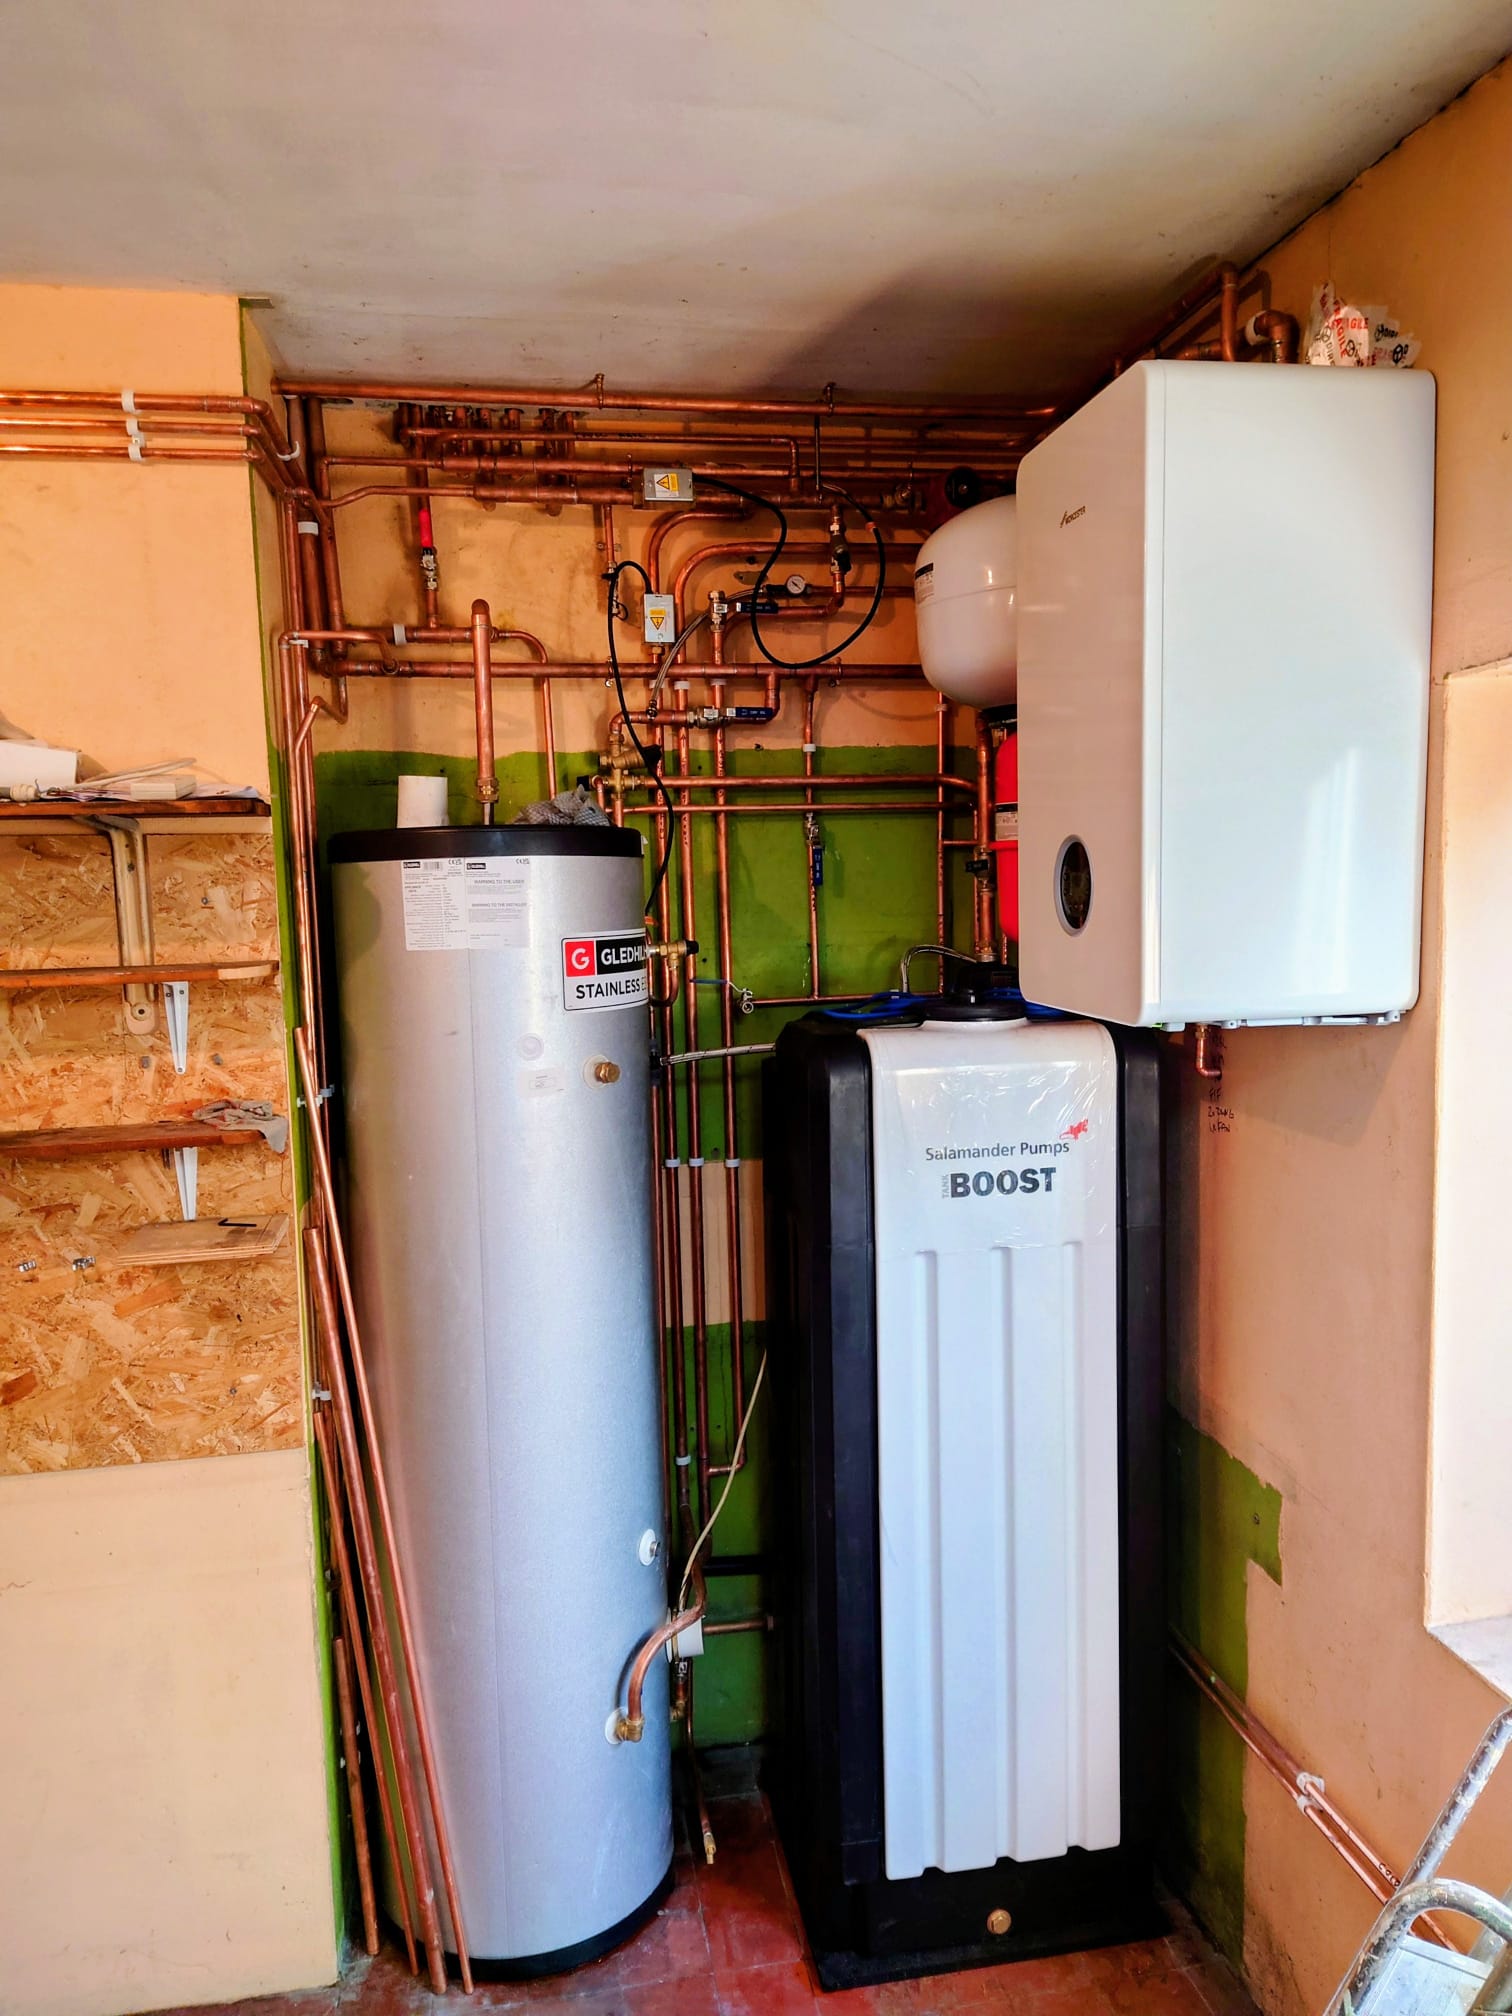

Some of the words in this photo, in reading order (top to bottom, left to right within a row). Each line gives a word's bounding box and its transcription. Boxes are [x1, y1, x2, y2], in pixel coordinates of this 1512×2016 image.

[571, 948, 590, 970] G
[576, 978, 641, 999] STAINLESS
[925, 1143, 1016, 1160] Salamander
[1020, 1142, 1070, 1157] Pumps
[951, 1167, 1057, 1198] BOOST
